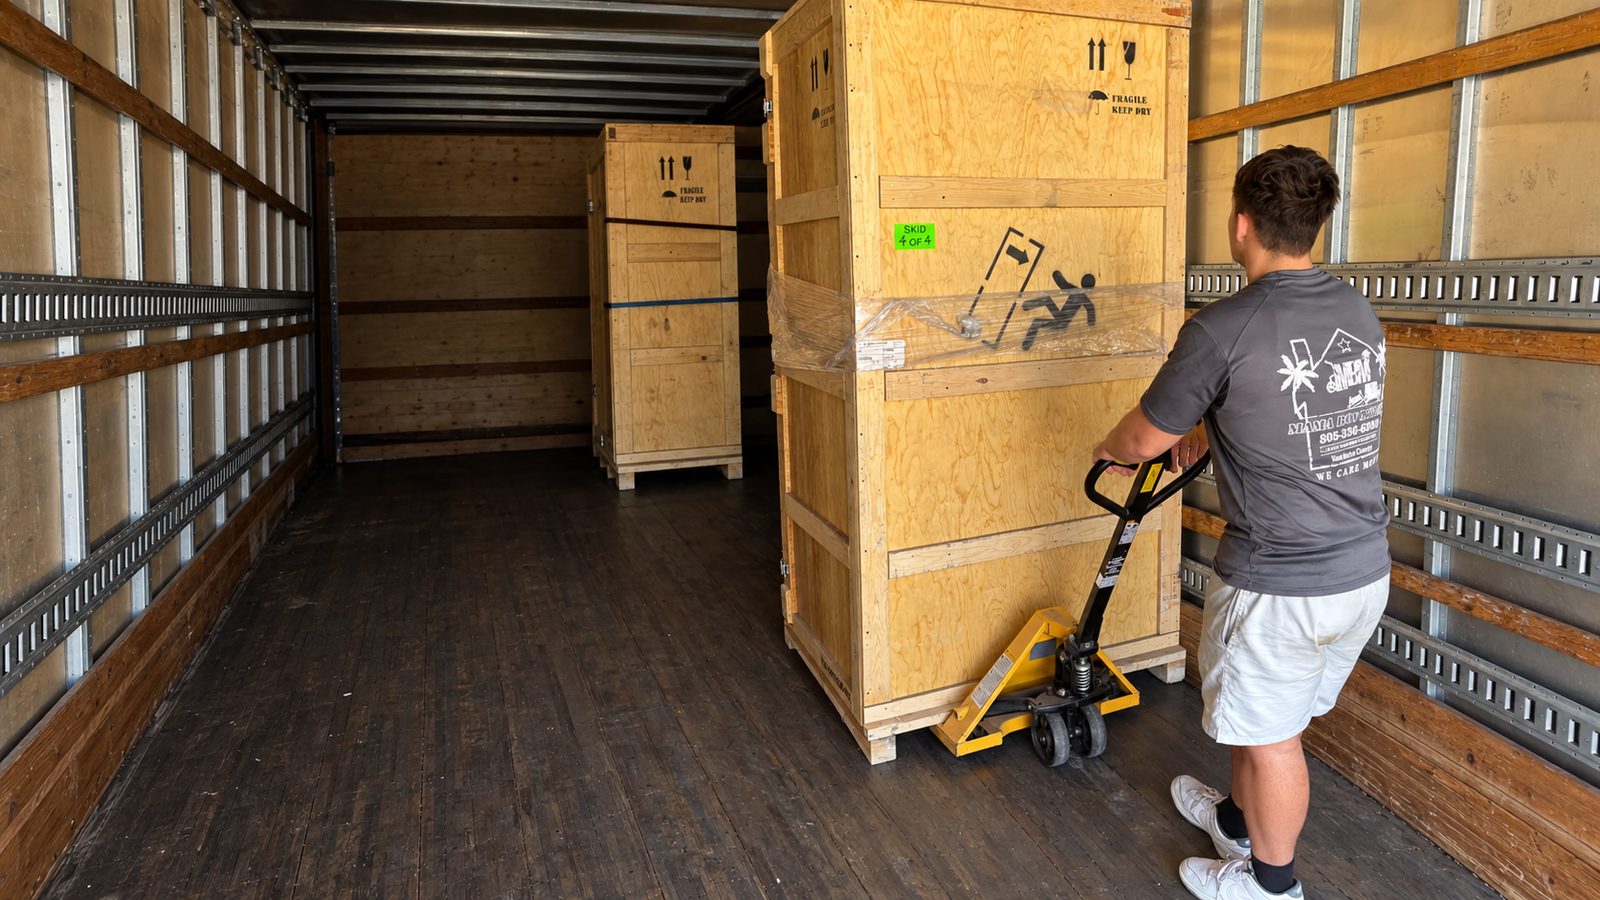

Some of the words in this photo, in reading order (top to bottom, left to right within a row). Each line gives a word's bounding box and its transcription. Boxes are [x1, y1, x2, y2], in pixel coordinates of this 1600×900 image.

[1112, 94, 1148, 105] FRAGILE
[1112, 106, 1133, 115] KEEP
[1135, 107, 1152, 116] DRY
[680, 186, 704, 195] FRAGILE
[903, 224, 927, 234] SKID
[899, 235, 907, 246] 4
[909, 237, 922, 247] OF
[924, 235, 932, 245] 4
[1316, 471, 1332, 481] WE
[1336, 463, 1360, 478] CARE
